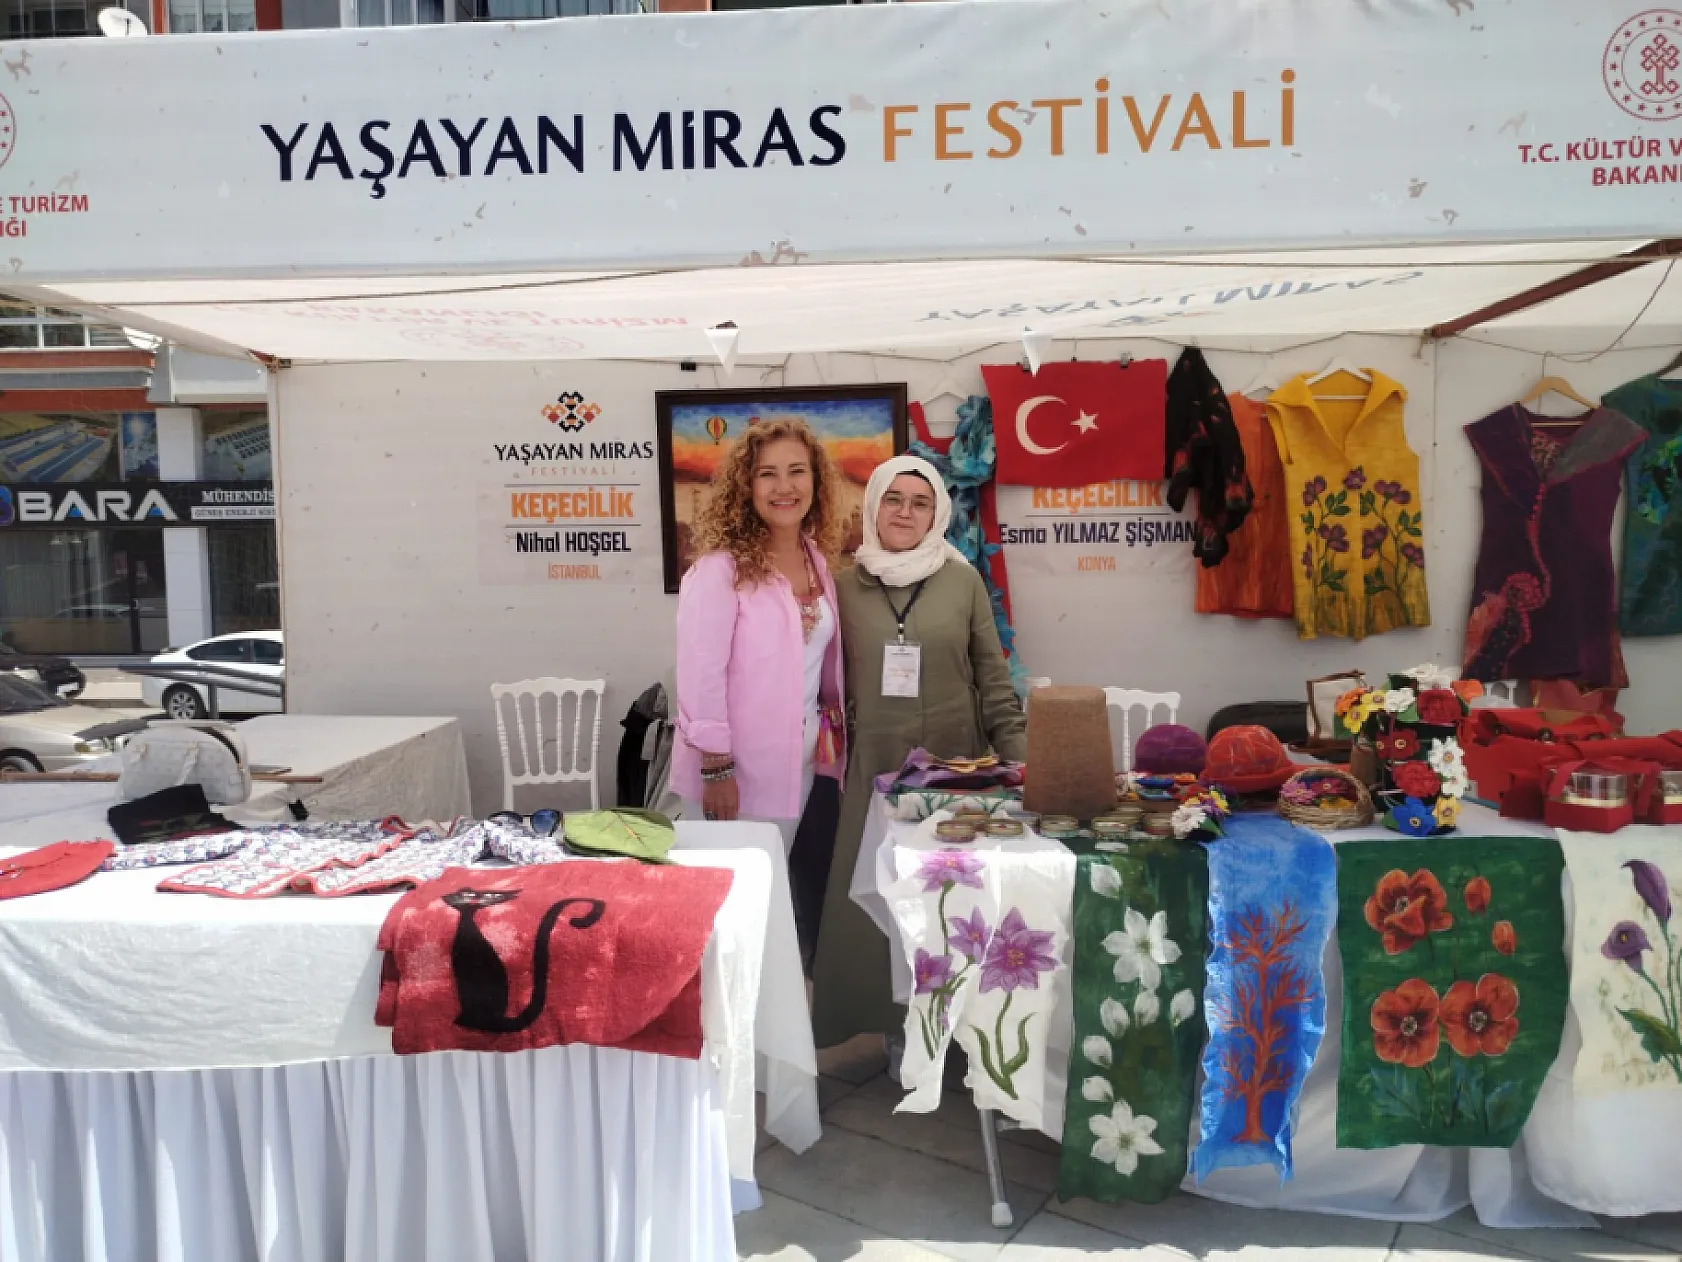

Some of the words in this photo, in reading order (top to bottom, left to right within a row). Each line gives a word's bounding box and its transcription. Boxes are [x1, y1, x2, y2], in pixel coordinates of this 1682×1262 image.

[261, 114, 585, 199] YAŞAYAN
[882, 68, 1296, 162] FESTİVALİ
[1518, 143, 1559, 163] T.C.
[1565, 136, 1661, 161] KÜLTÜR
[9, 191, 88, 213] TURİZM
[493, 442, 583, 465] YAŞAYAN
[531, 463, 616, 477] FESTİVALİ
[18, 489, 179, 522] BARA
[511, 486, 635, 523] KEÇECİLİK
[516, 531, 560, 553] Nihal
[565, 531, 631, 556] HOŞGEL
[999, 523, 1048, 544] Esma
[1053, 521, 1120, 544] YILMAZ
[1125, 517, 1195, 548] ŞİŞMAN
[548, 561, 602, 580] İSTANBUL
[1077, 555, 1116, 571] KONYA
